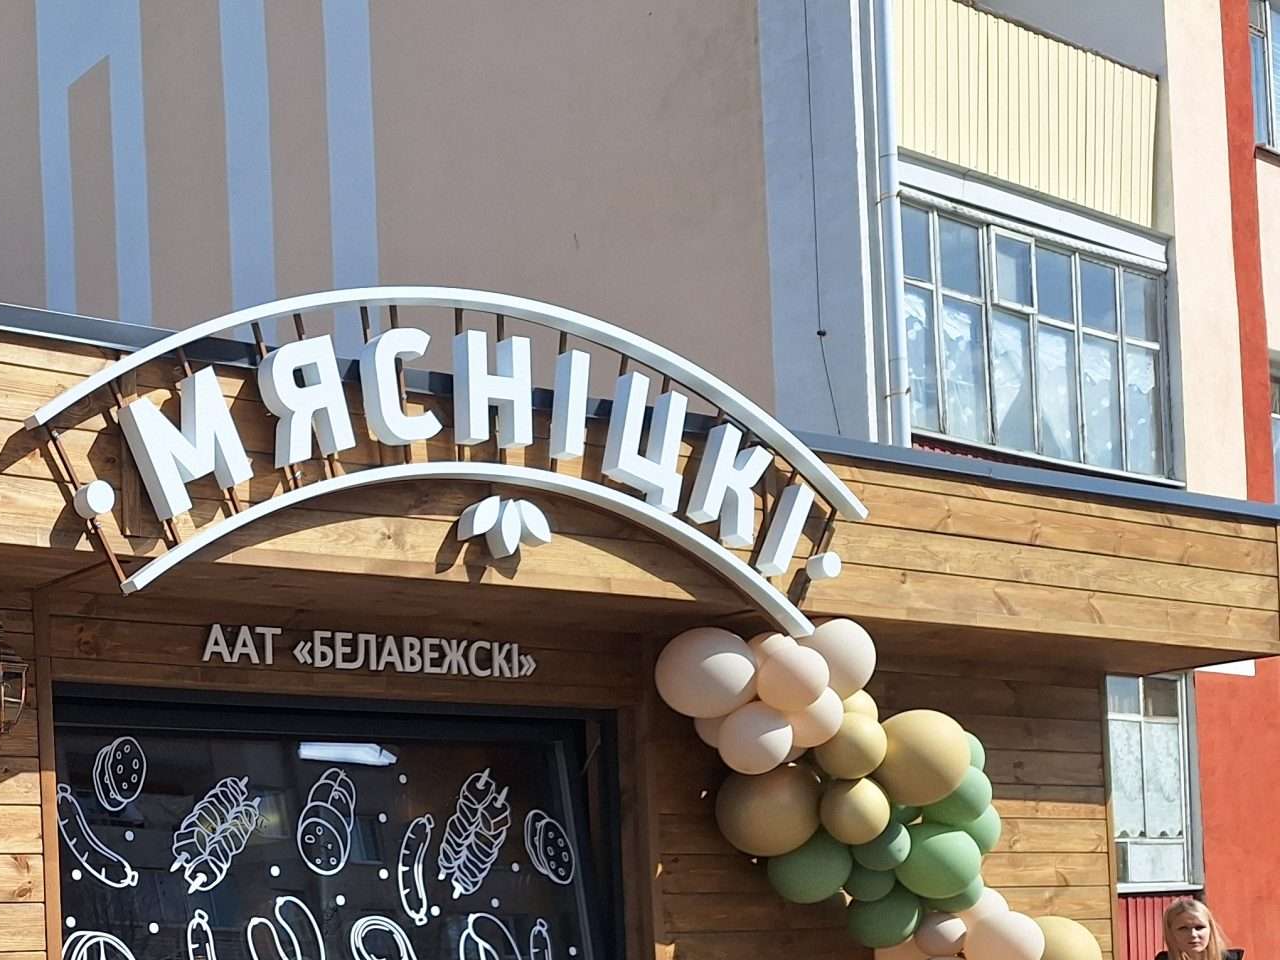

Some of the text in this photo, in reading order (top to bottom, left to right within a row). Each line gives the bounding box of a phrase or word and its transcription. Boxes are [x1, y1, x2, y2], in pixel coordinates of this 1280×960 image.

[119, 327, 814, 577] МЯСНІЦКІ
[203, 623, 537, 679] ААТ «БЕЛАВЕЖСКІ»
